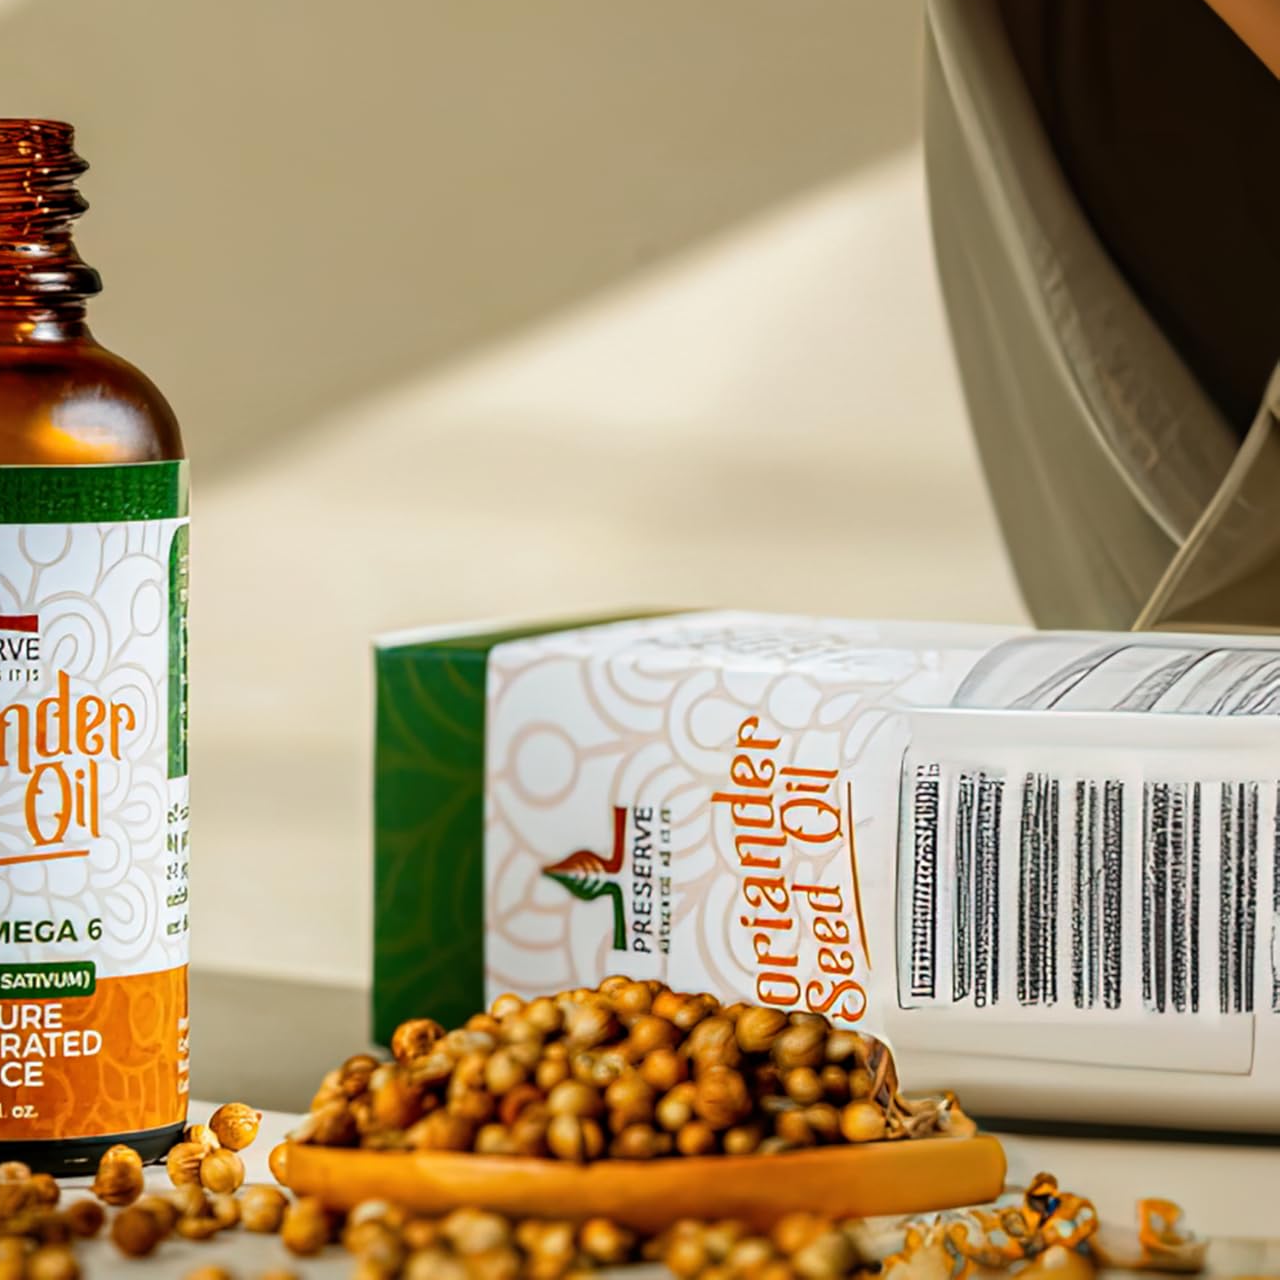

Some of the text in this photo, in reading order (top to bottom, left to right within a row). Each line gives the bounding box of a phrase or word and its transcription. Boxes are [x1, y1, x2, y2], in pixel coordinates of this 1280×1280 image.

[25, 759, 101, 847] Oil
[710, 715, 802, 1007] oriander
[88, 918, 103, 940] 6
[632, 806, 654, 954] PRESERVE
[779, 766, 867, 1023] Seed Oil
[1, 969, 91, 989] SATIVUM)
